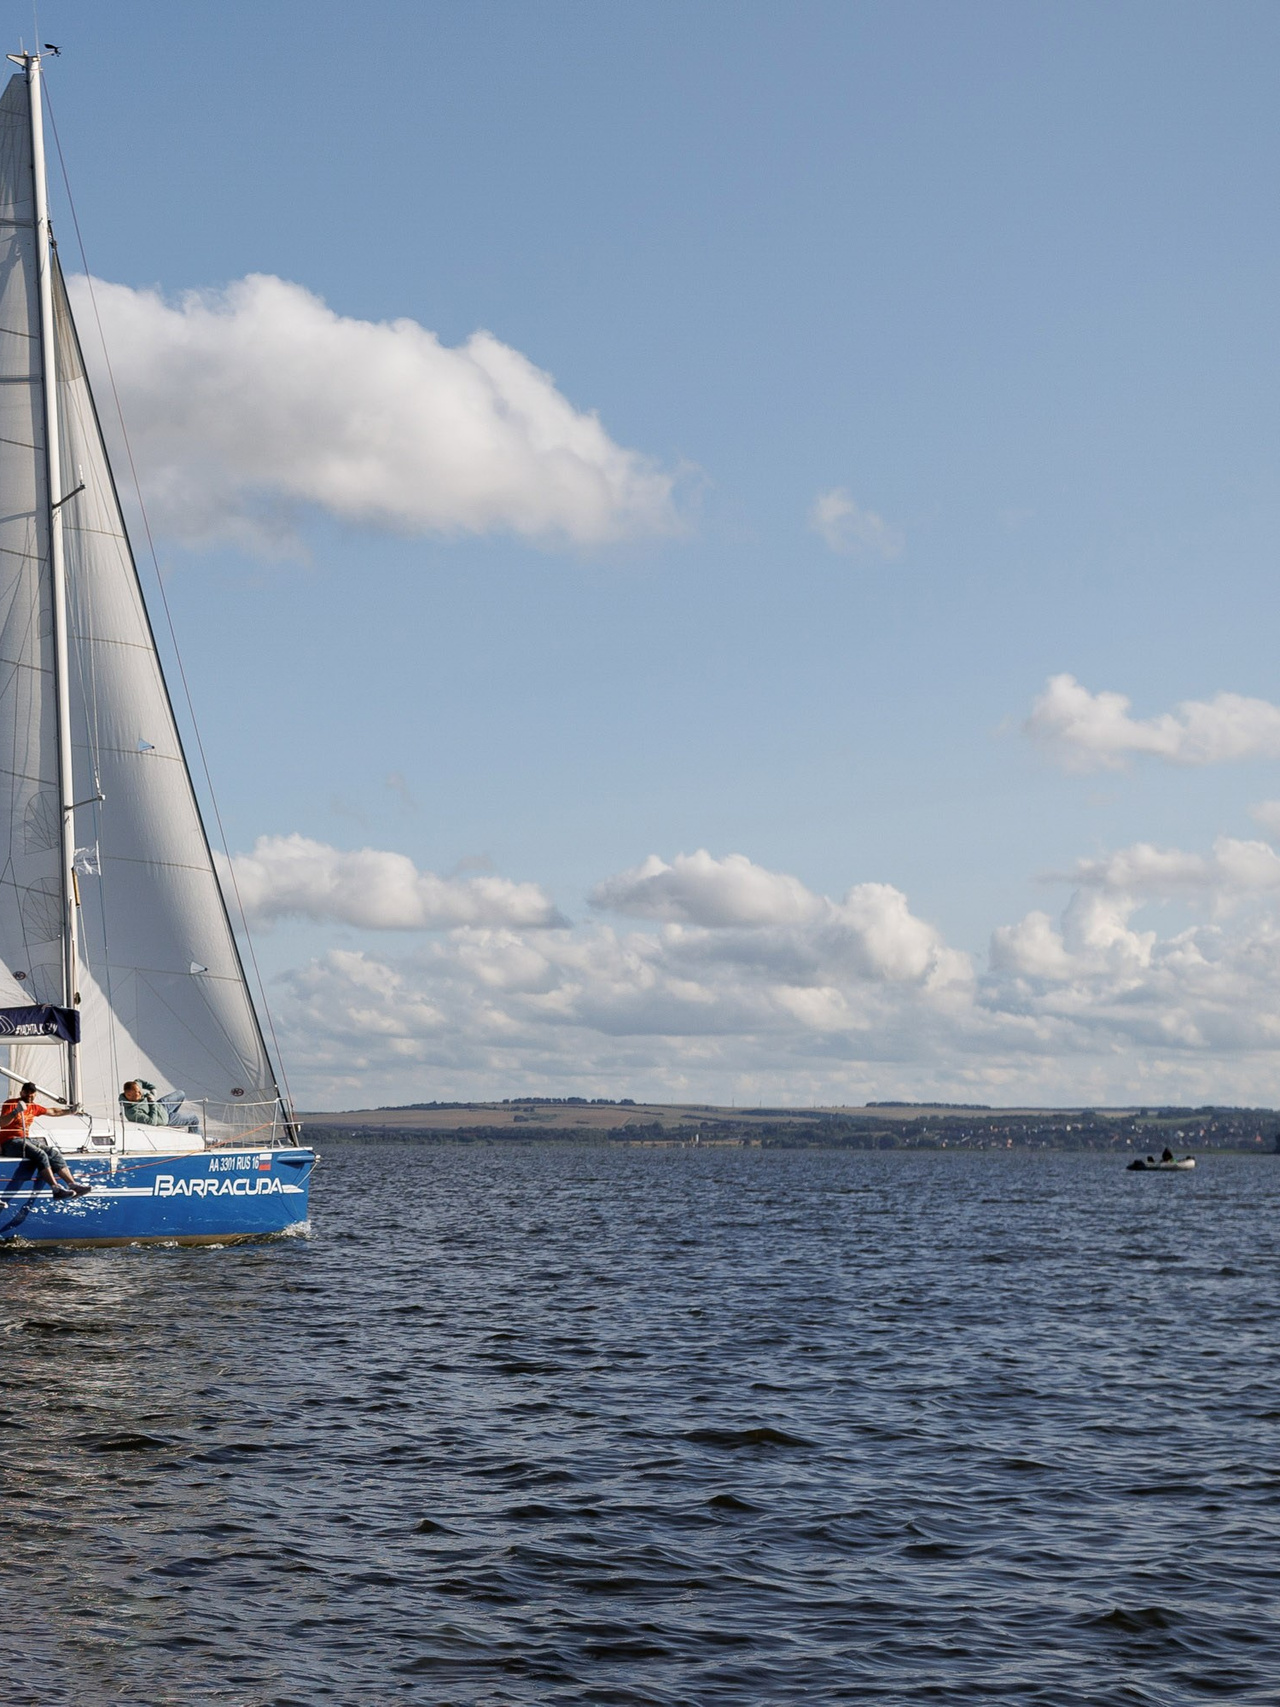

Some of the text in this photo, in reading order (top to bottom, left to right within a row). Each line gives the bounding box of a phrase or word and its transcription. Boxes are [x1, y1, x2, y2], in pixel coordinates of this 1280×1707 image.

[209, 1158, 219, 1172] AA
[236, 1155, 251, 1170] RUS
[252, 1155, 260, 1169] 16
[154, 1175, 283, 1196] BARRACUDA
